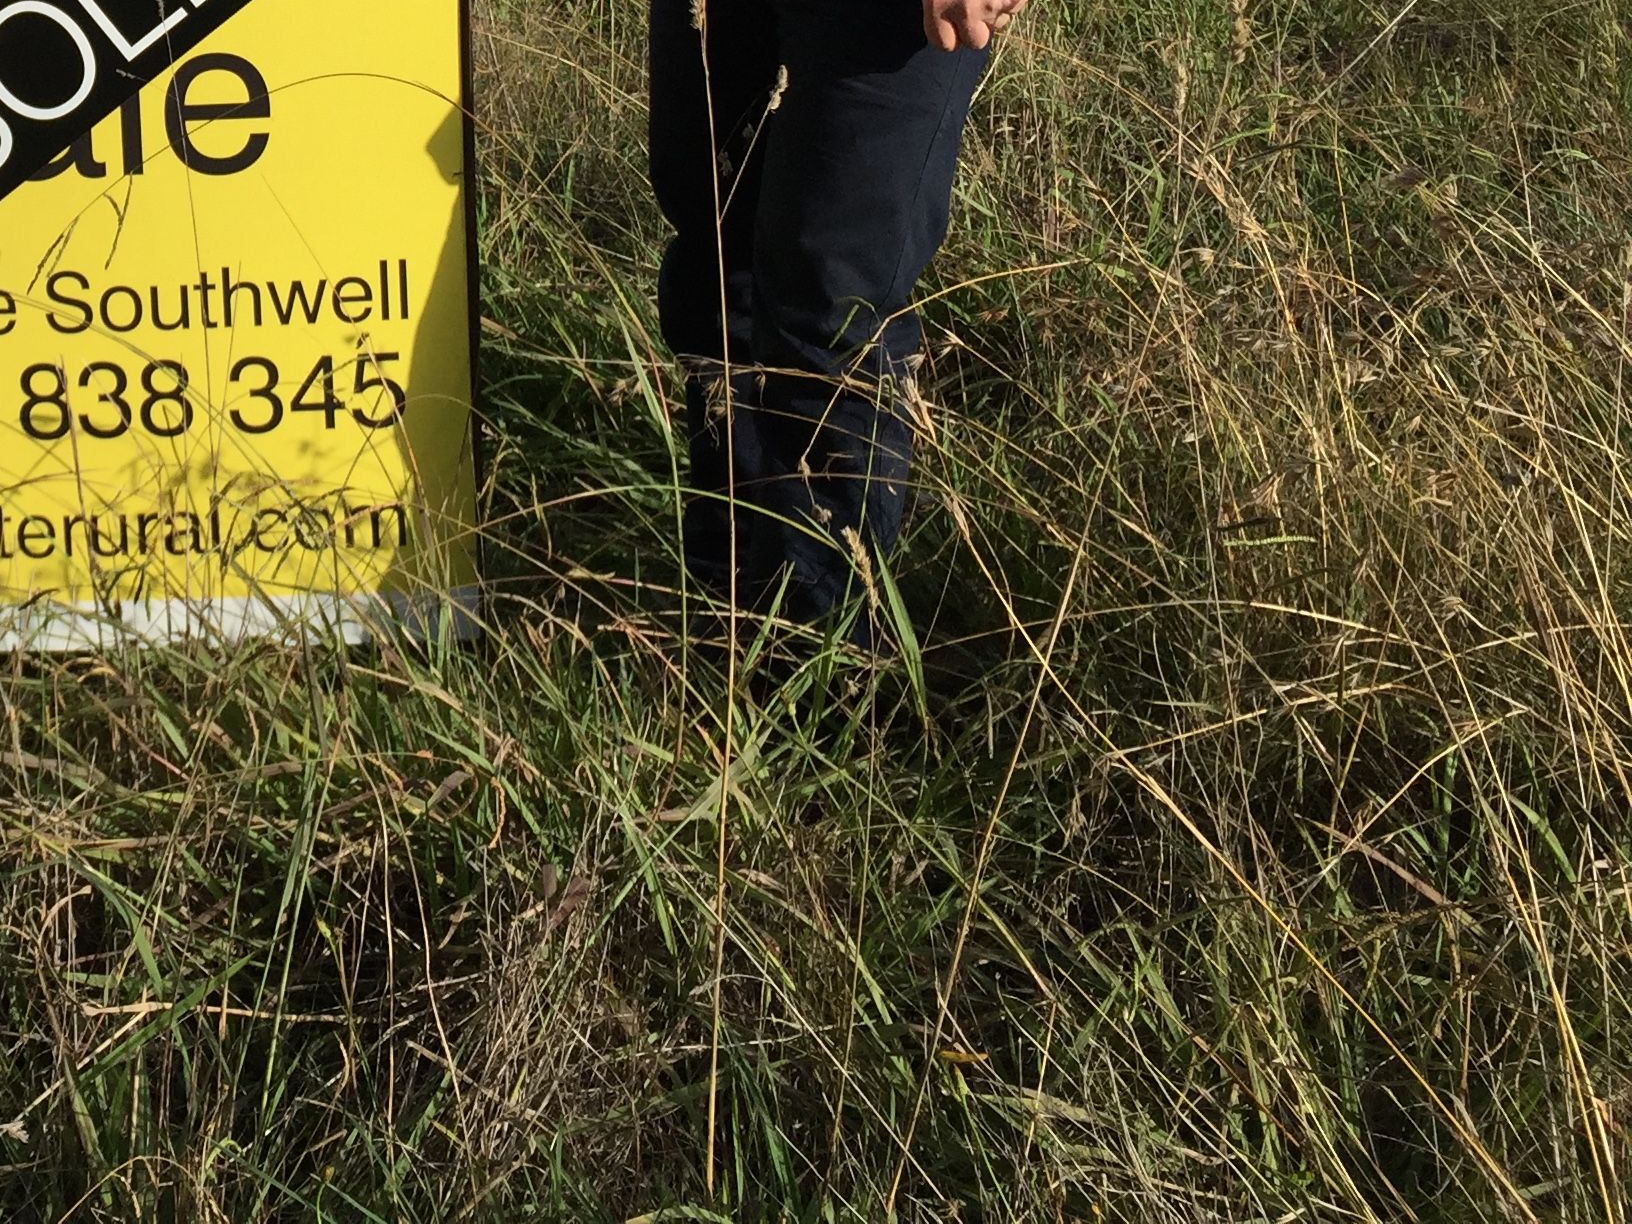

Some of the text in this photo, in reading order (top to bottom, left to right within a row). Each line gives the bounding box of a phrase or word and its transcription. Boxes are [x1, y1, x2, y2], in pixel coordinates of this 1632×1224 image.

[45, 258, 410, 334] Southwell
[19, 359, 194, 440] 838
[229, 352, 405, 436] 345
